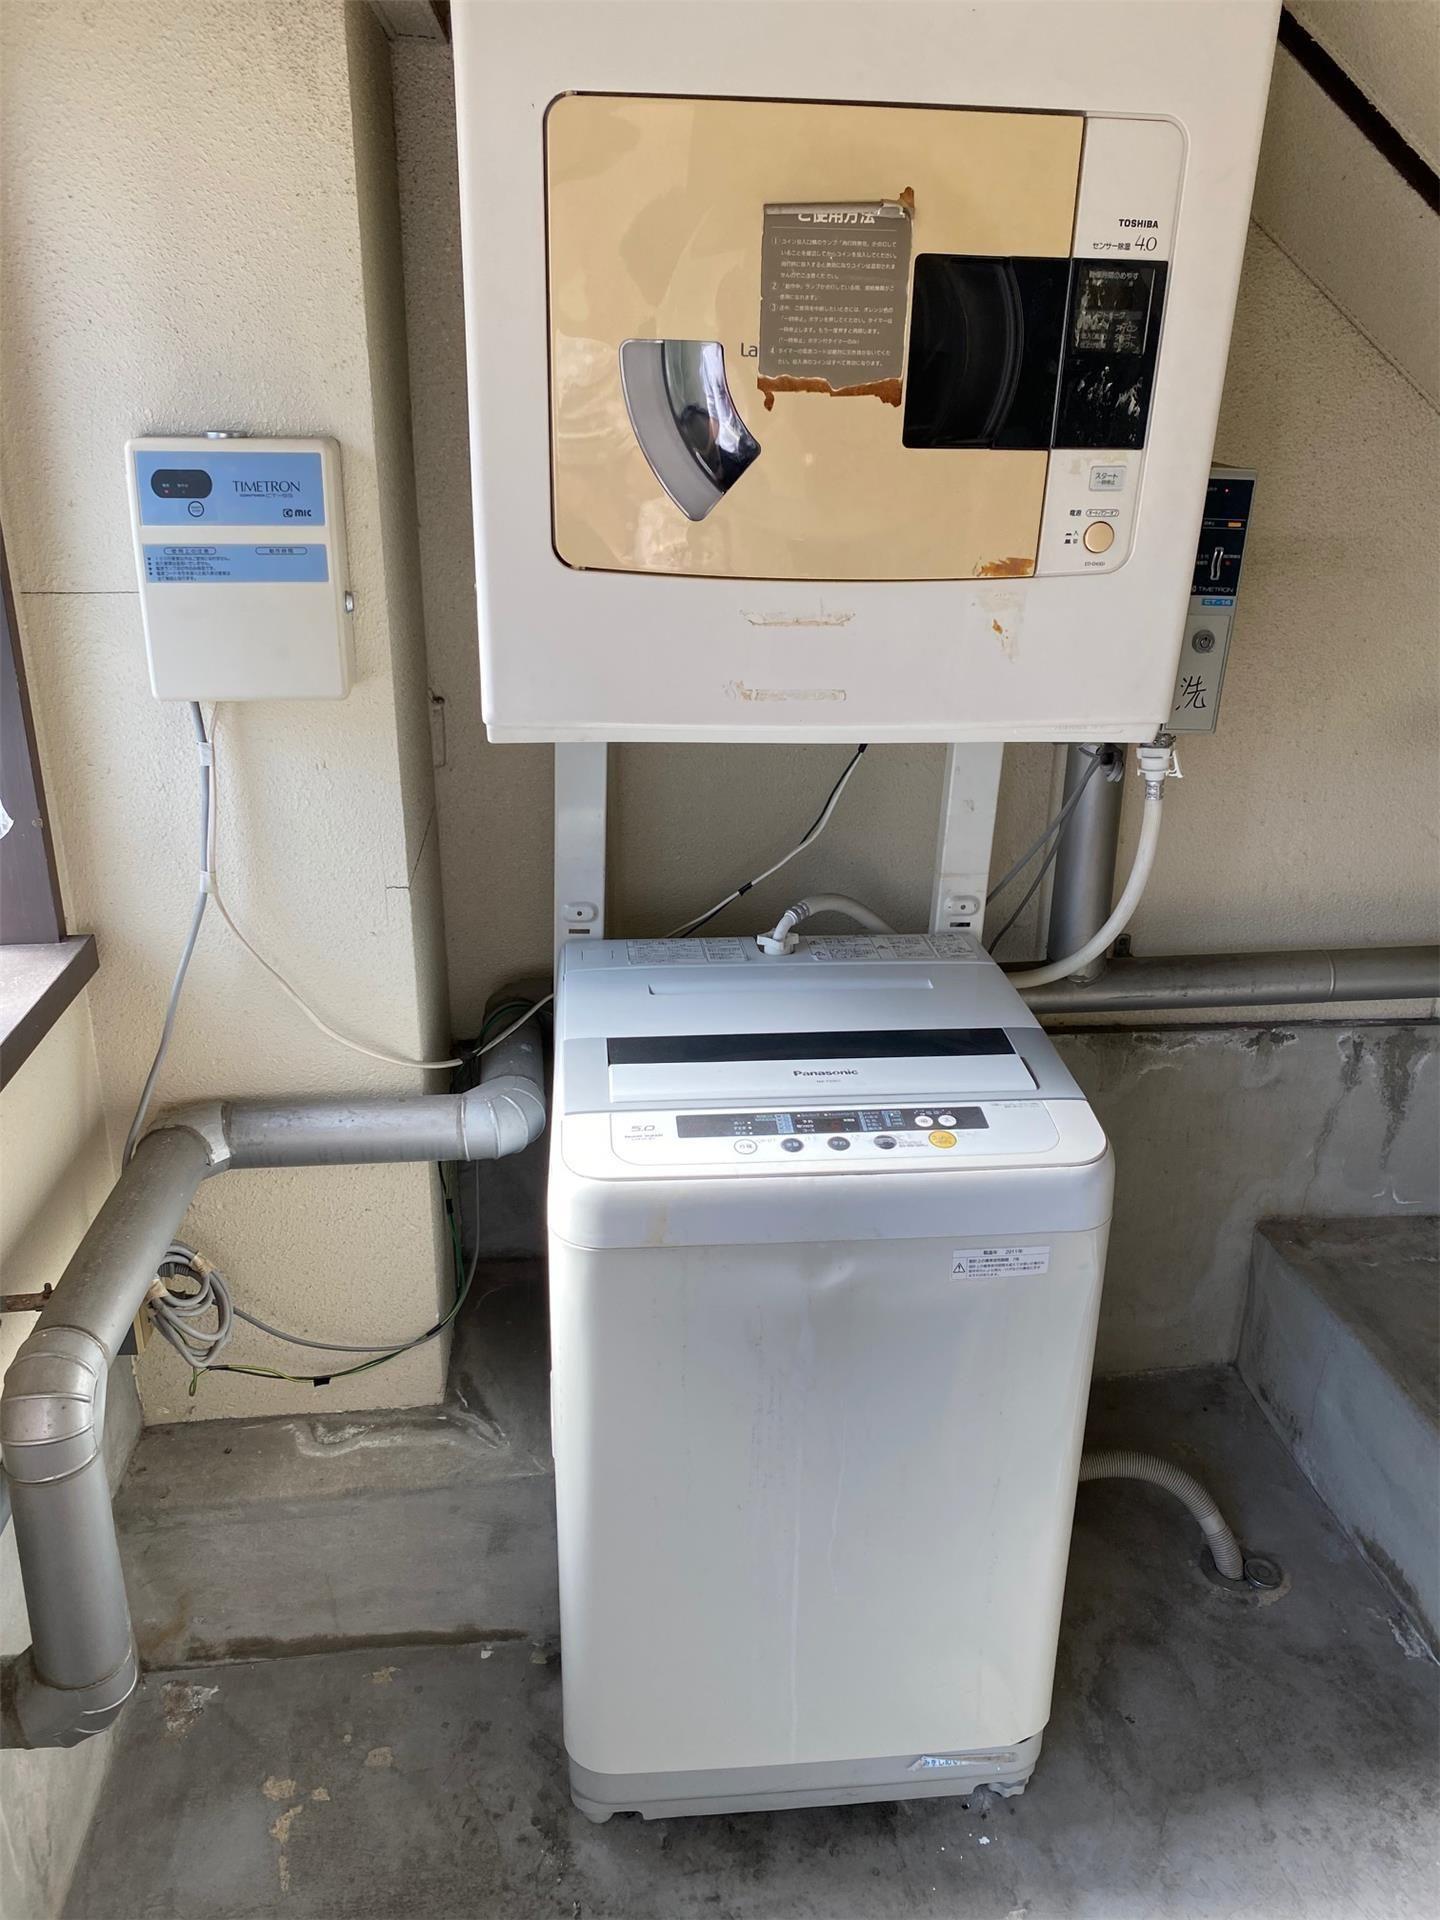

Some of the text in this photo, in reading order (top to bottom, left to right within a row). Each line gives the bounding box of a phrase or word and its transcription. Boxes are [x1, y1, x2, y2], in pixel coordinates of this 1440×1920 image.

[1118, 218, 1158, 229] TOSHIBA
[1092, 234, 1158, 252] センサー除湿 4.0
[1095, 472, 1119, 480] スタート
[232, 480, 301, 493] TIMETRON
[1175, 675, 1207, 711] 洗
[792, 1068, 859, 1077] Panasonic
